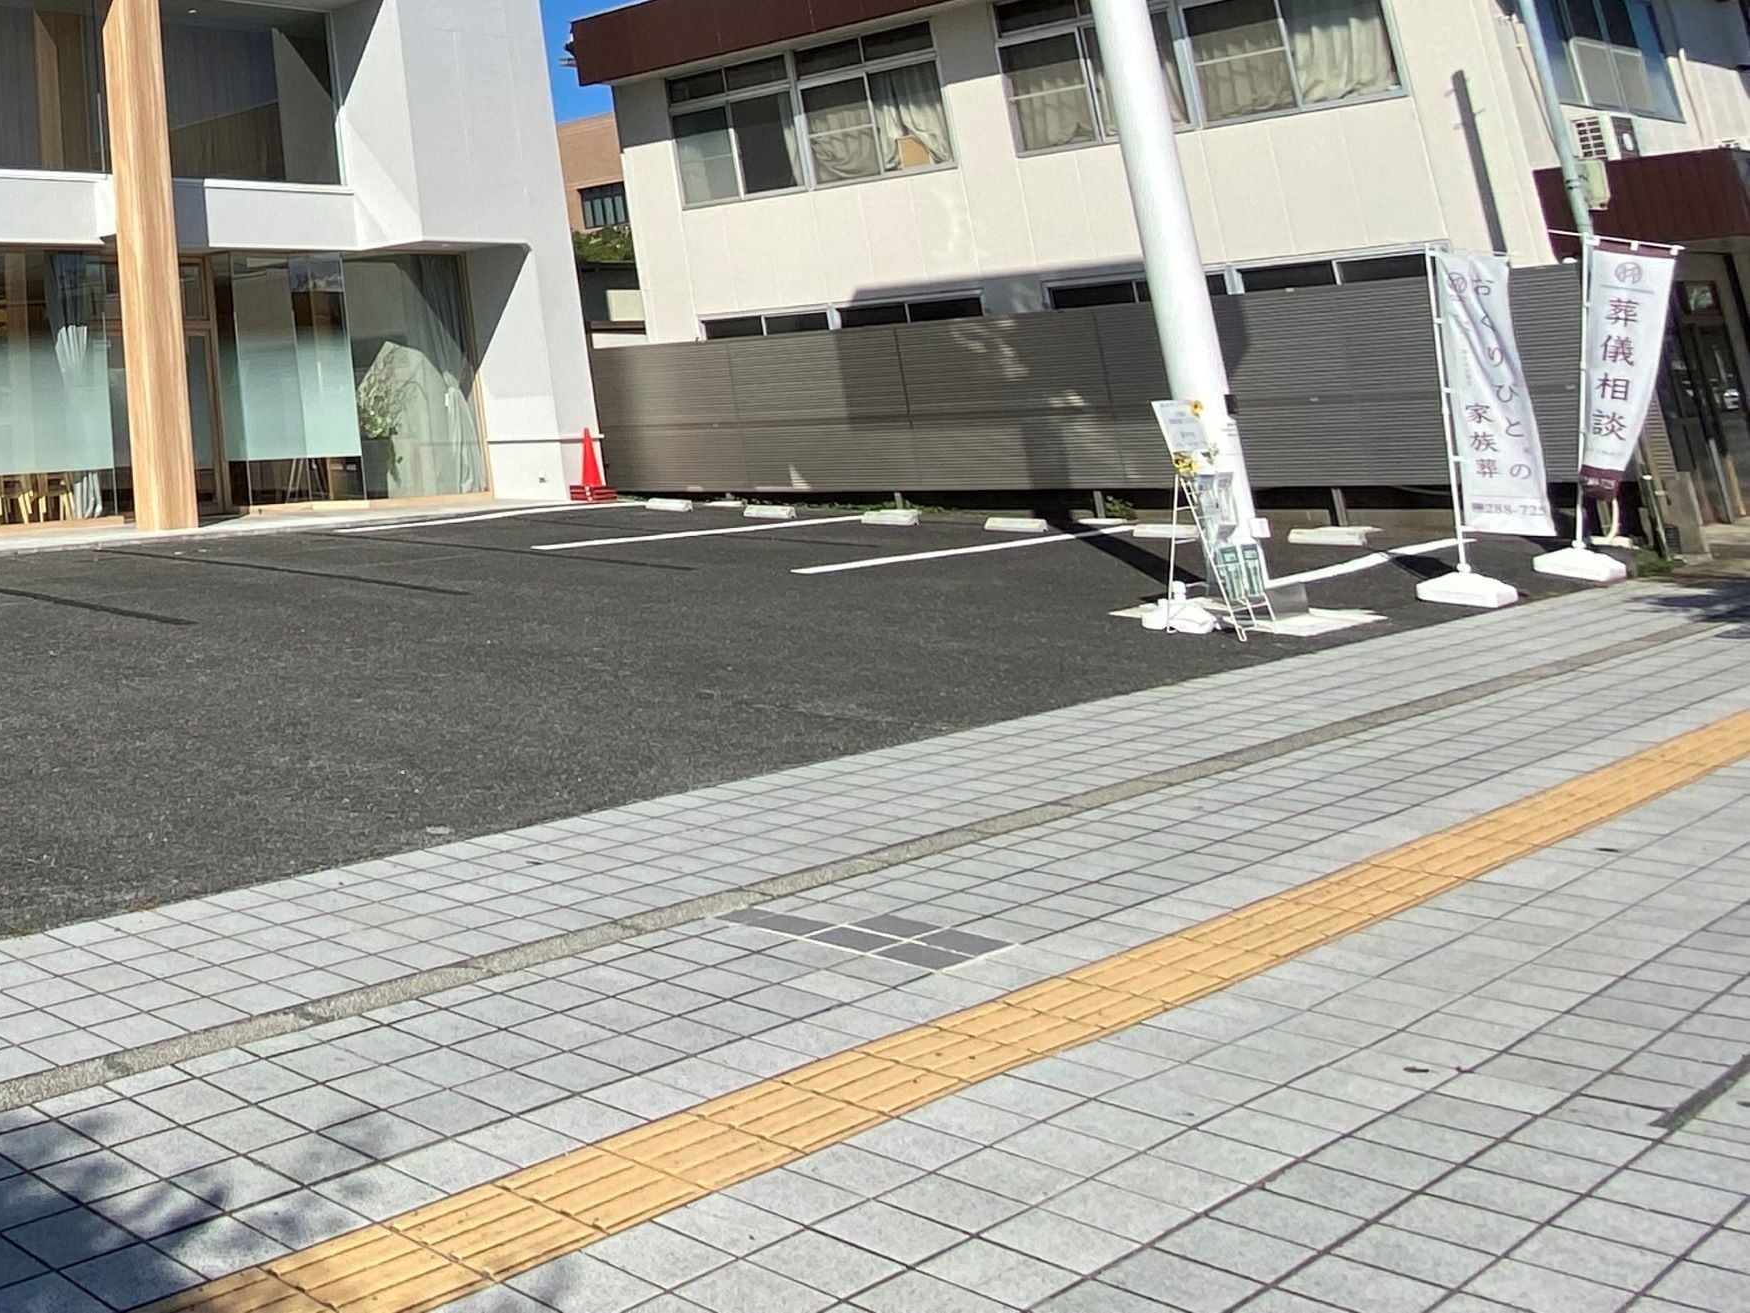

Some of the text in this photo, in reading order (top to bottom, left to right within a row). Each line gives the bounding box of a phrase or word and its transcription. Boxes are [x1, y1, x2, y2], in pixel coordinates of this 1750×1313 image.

[1591, 297, 1641, 441] 葬儀相談
[1465, 402, 1501, 478] 家族葬
